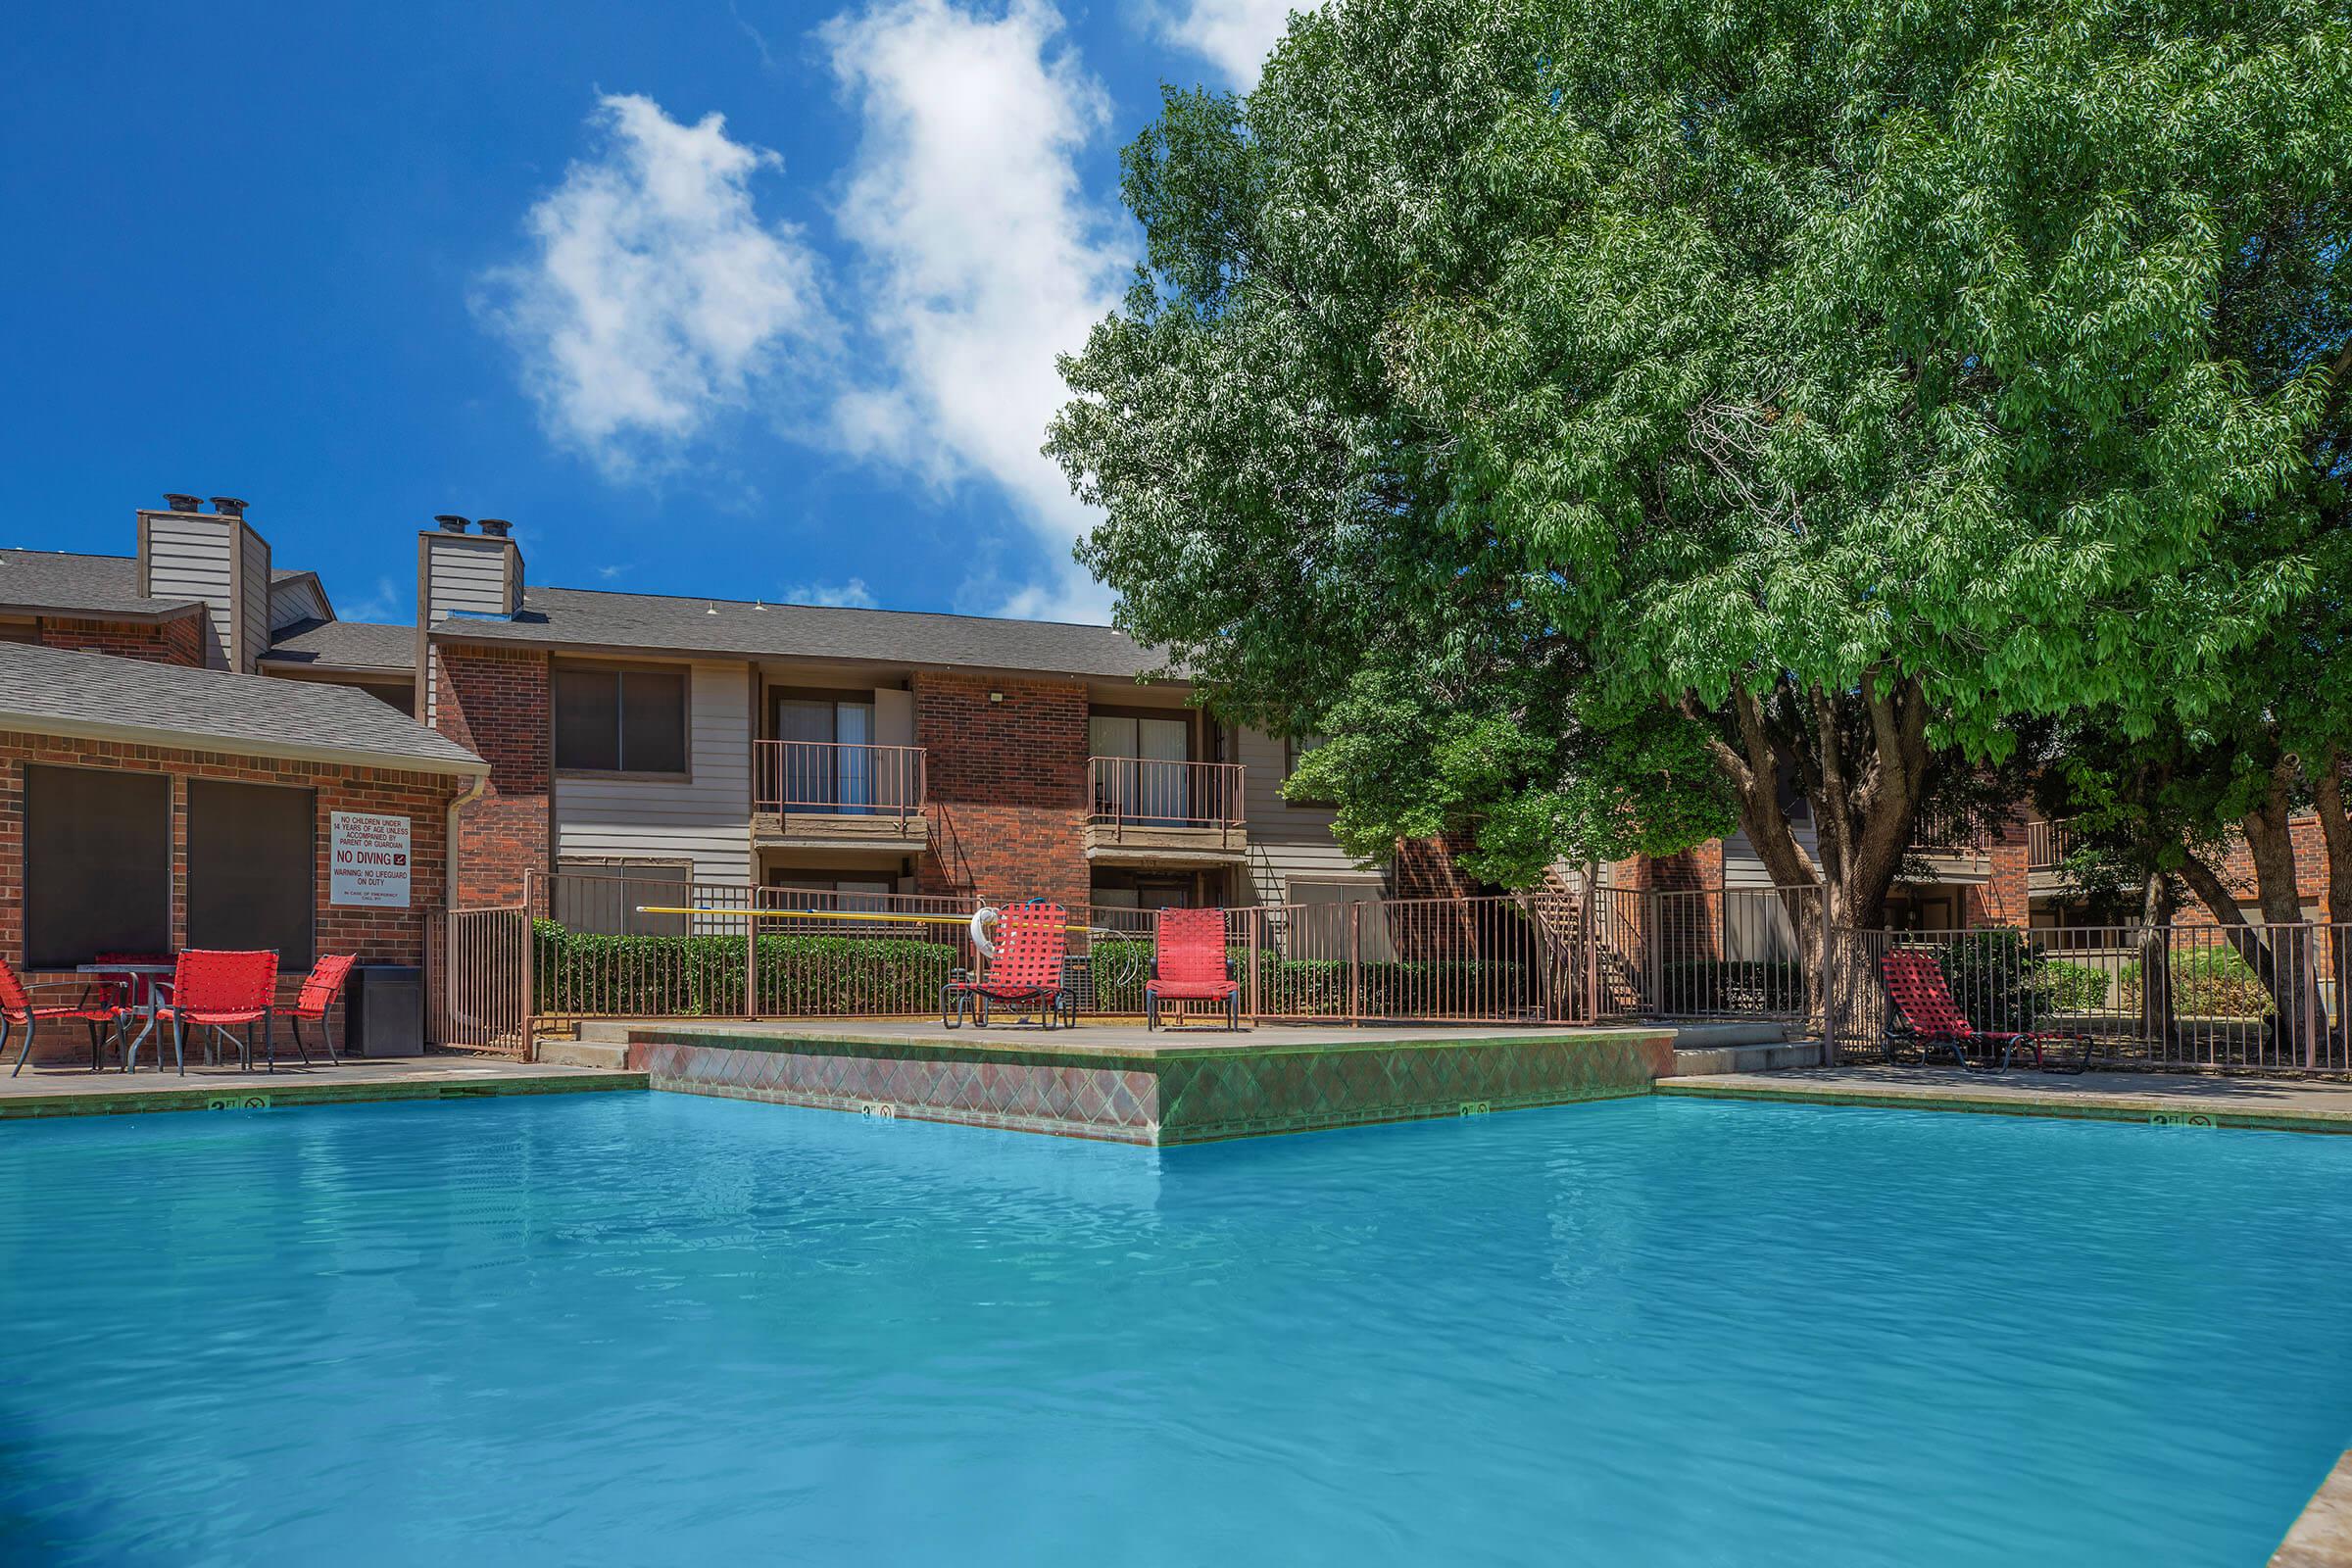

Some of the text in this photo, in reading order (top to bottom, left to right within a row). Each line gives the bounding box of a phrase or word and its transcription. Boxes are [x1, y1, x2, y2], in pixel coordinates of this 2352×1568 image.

[346, 832, 387, 840] ACCOMPANIED
[374, 841, 403, 849] GUARDIAN
[337, 850, 391, 865] NO DIVING
[334, 868, 363, 877] WARNING:
[376, 871, 407, 879] LIFEGUARD
